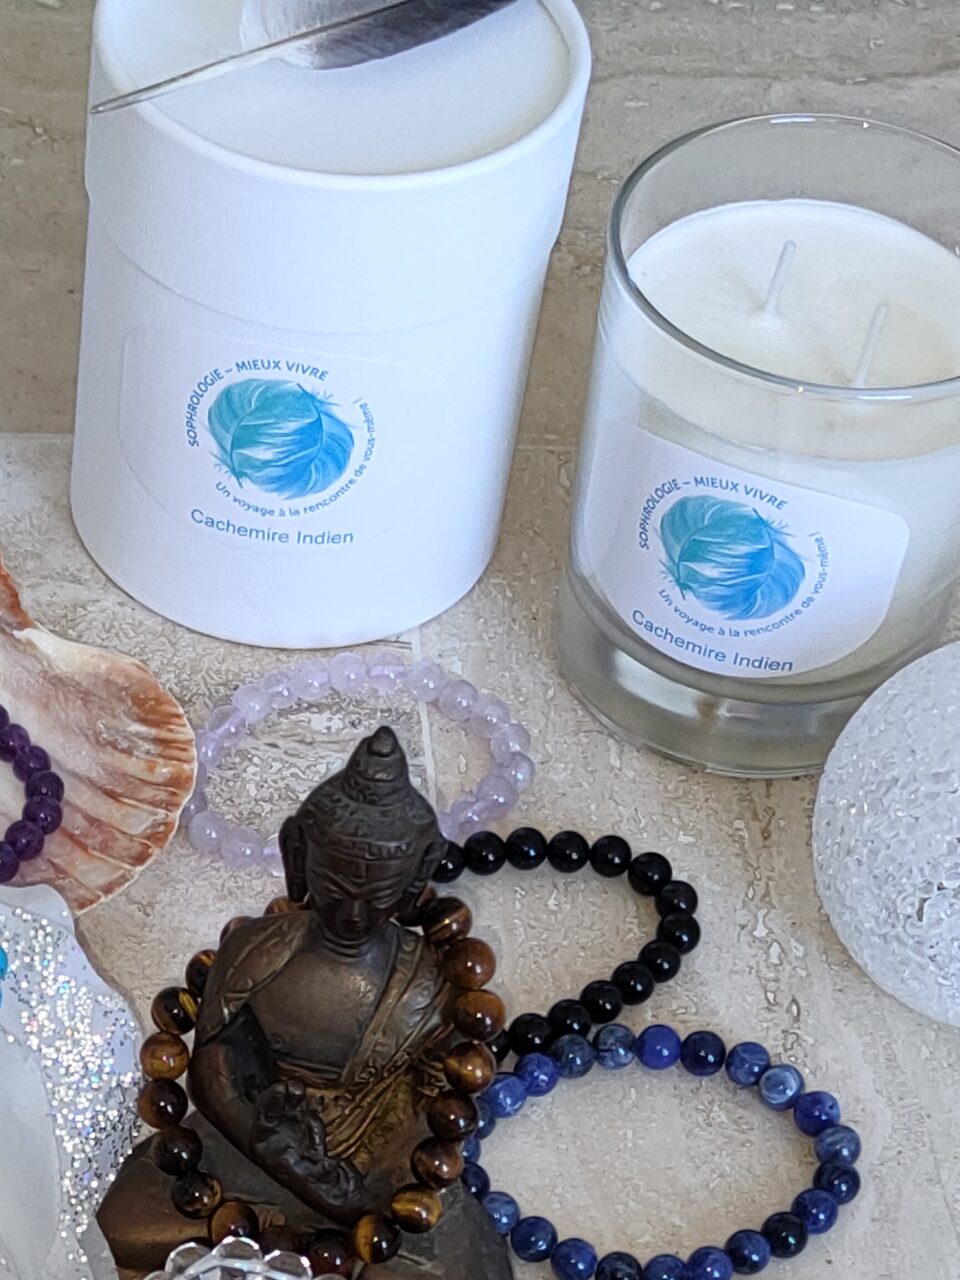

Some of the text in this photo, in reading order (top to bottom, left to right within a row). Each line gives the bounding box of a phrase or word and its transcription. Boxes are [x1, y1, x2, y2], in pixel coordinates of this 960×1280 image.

[186, 368, 224, 448] SOPHROLOGIE
[235, 359, 281, 371] MIEUX
[285, 361, 328, 382] VIVRE
[216, 481, 231, 498] Un
[233, 495, 275, 517] voyage
[279, 507, 286, 517] à
[289, 507, 301, 516] la
[303, 478, 357, 515] rencontre
[354, 465, 367, 478] de
[639, 478, 681, 550] SOPHROLOGIE
[694, 476, 740, 493] MIEUX
[744, 485, 788, 511] VIVRE
[190, 508, 354, 545] Cachemire Indien
[658, 588, 672, 607] Un
[674, 607, 714, 634] voyage
[718, 626, 725, 636] à
[728, 627, 740, 638] la
[744, 609, 803, 638] rencontre
[801, 595, 815, 609] de
[813, 536, 829, 595] vous-même
[631, 609, 793, 672] Cachemire Indien
